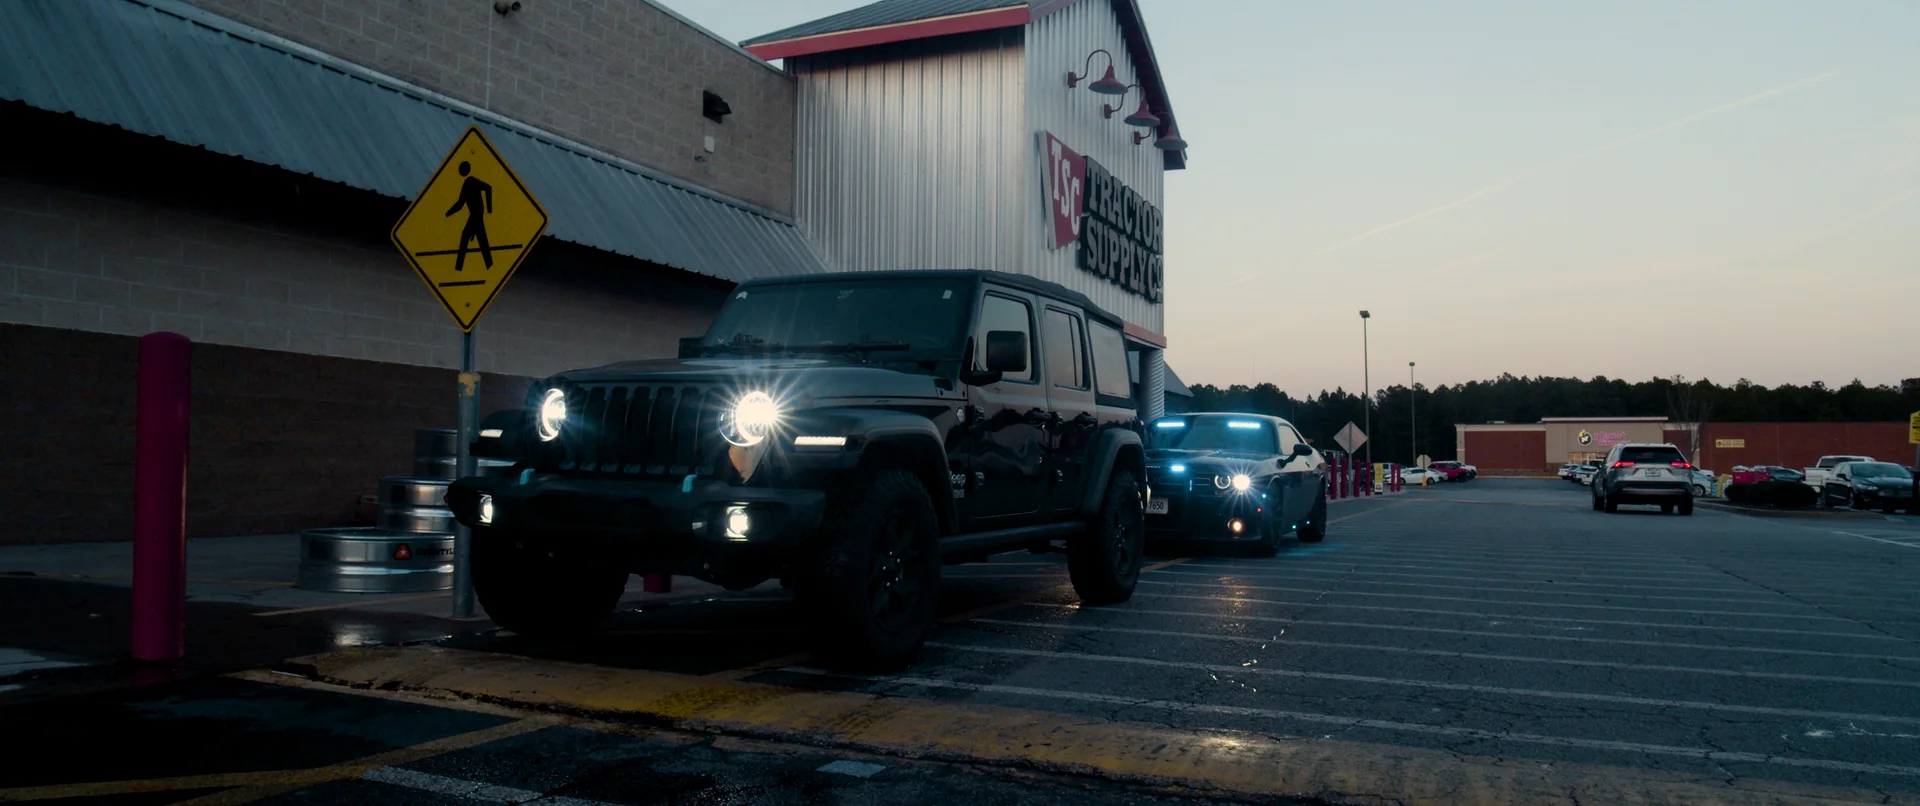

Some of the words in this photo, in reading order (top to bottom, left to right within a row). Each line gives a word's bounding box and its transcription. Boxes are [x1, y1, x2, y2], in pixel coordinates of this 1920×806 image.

[1051, 138, 1080, 236] TSC
[1086, 156, 1163, 255] TRACTOR
[1085, 215, 1148, 296] SUPPLY
[950, 471, 967, 487] eep
